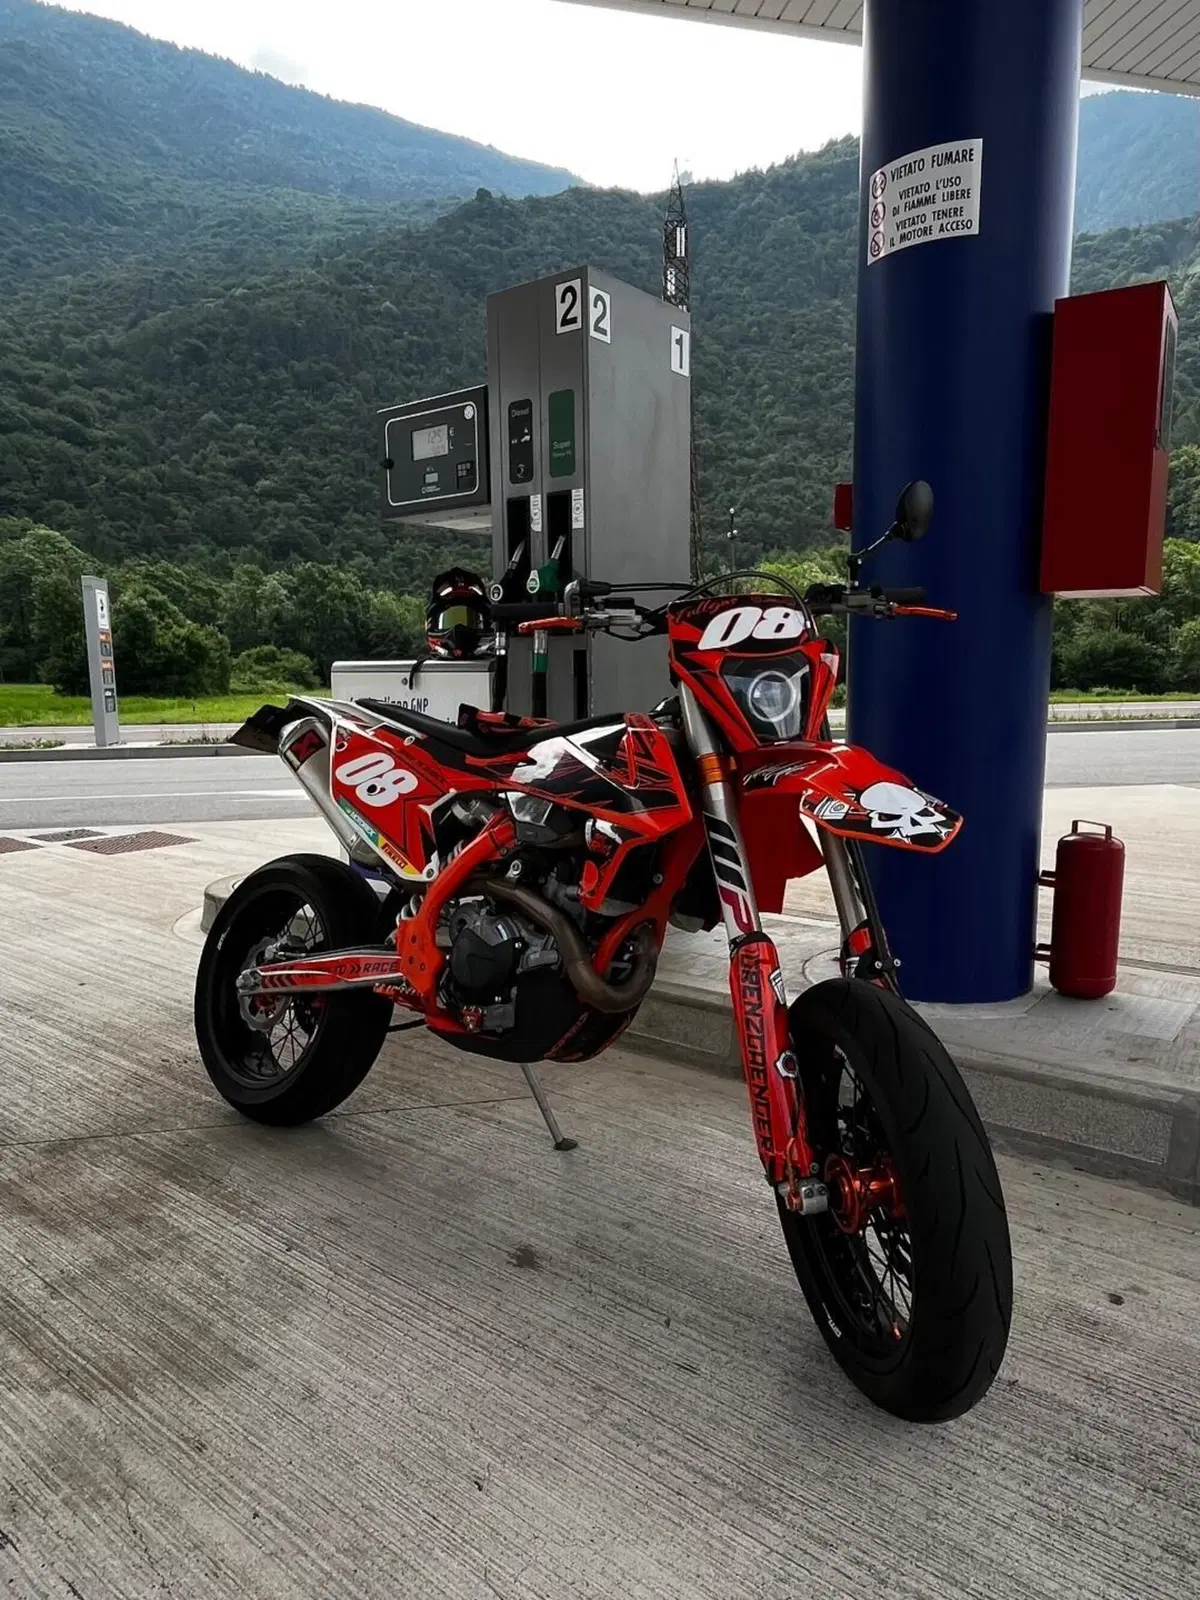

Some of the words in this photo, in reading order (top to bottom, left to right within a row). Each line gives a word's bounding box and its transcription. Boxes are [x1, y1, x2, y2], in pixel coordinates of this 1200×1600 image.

[891, 158, 925, 182] VIETATO
[931, 148, 974, 168] FUMARE
[892, 206, 900, 217] DI
[904, 194, 937, 212] FIAMME
[942, 188, 972, 202] LIBERE
[899, 182, 930, 200] VIETATO
[936, 176, 962, 190] L'USO
[890, 238, 895, 248] IL
[899, 225, 933, 244] MOTORE
[938, 219, 973, 234] ACCESO
[895, 213, 927, 232] VIETATO
[932, 206, 964, 221] TENERE
[560, 285, 578, 327] 2
[593, 293, 608, 336] 2
[675, 334, 684, 370] 1
[552, 440, 571, 450] Super
[698, 606, 806, 650] 08
[411, 698, 429, 713] GNP
[335, 752, 418, 807] 08
[362, 962, 397, 973] RACE
